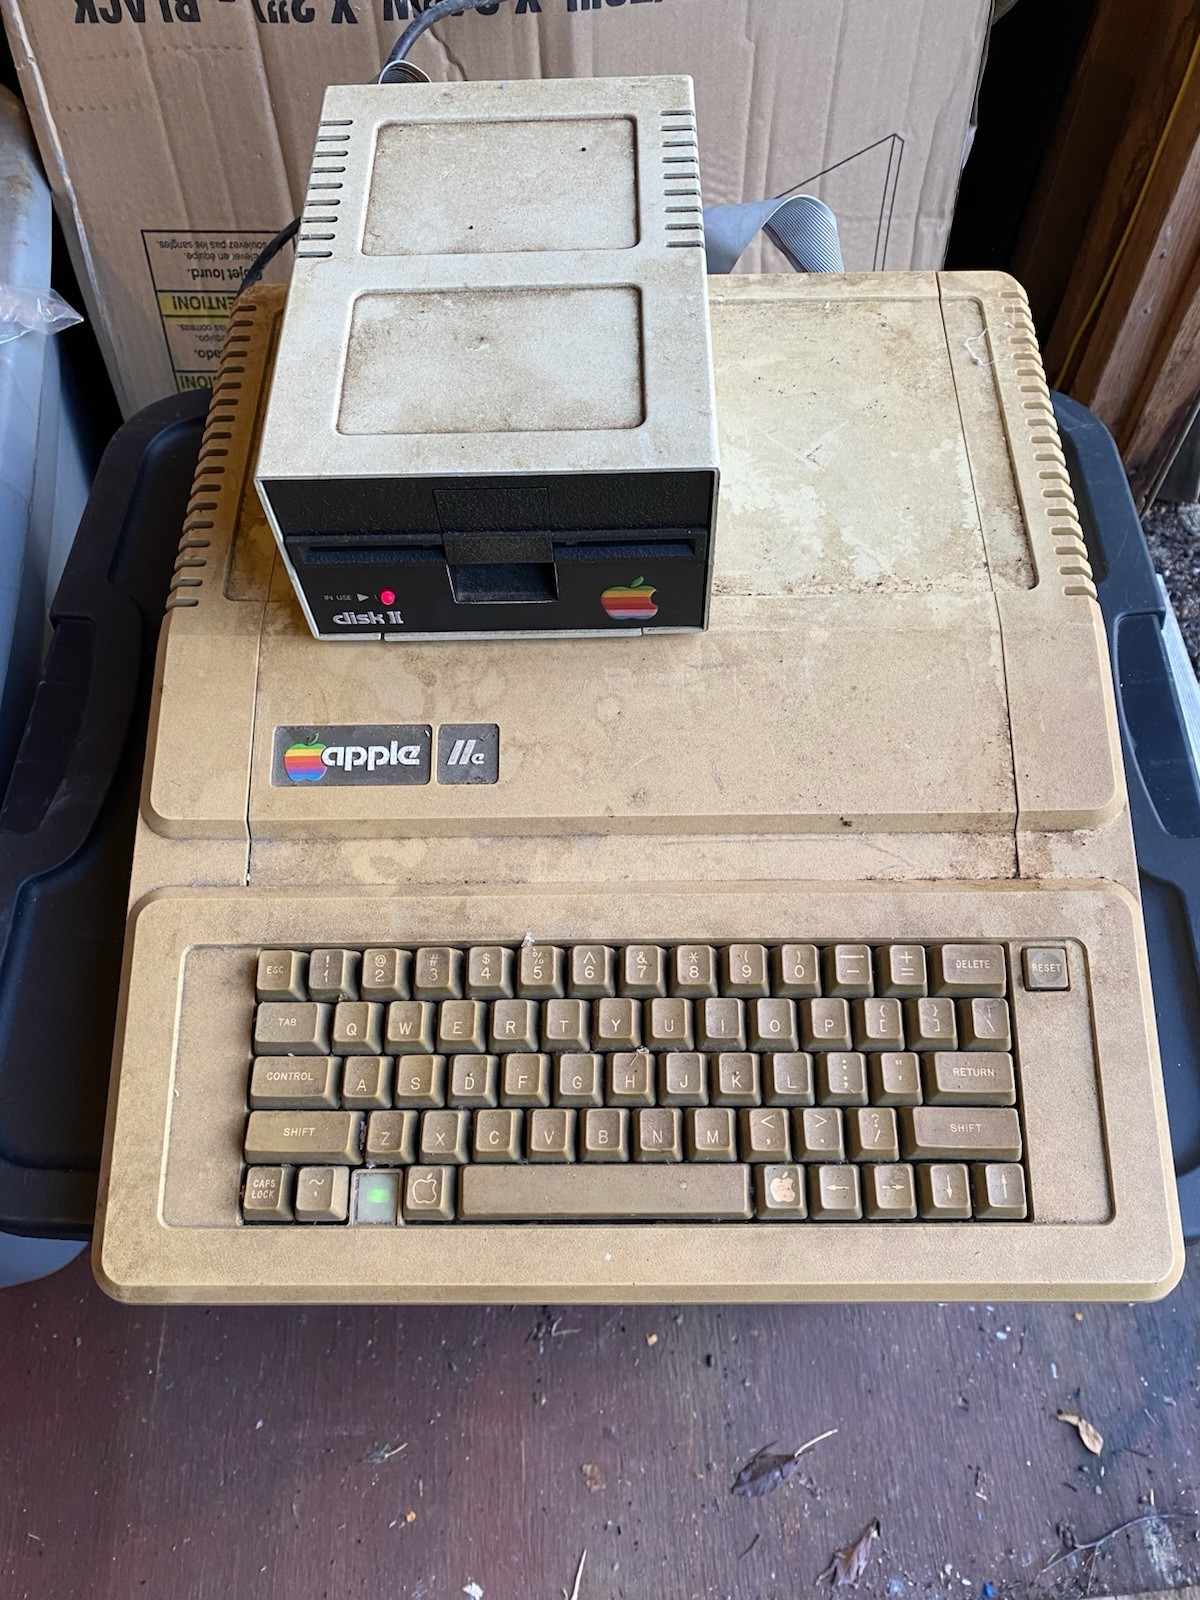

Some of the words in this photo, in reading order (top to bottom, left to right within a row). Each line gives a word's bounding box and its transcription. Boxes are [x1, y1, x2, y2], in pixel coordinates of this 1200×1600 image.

[187, 268, 225, 281] lourd.
[332, 611, 386, 625] disk
[320, 740, 420, 772] apple
[326, 955, 330, 967] !
[374, 955, 386, 967] @
[428, 954, 439, 966] #
[482, 952, 490, 964] $
[532, 950, 544, 964] %
[637, 951, 648, 964] &
[744, 950, 748, 962] (
[796, 950, 801, 962] )
[900, 952, 913, 964] +
[266, 966, 284, 974] ESC
[956, 960, 990, 969] DELETE
[1032, 963, 1061, 972] RESET
[324, 971, 328, 982] 1
[375, 970, 385, 982] 2
[428, 968, 438, 980] 3
[481, 968, 490, 980] 4
[534, 966, 542, 980] 5
[584, 966, 595, 978] 6
[638, 966, 647, 978] 7
[690, 966, 699, 978] 8
[742, 965, 752, 978] 9
[902, 968, 914, 976] =
[878, 1005, 885, 1018] {
[932, 1004, 939, 1017] }
[278, 1018, 297, 1026] TAB
[453, 1022, 462, 1034] E
[506, 1020, 516, 1034] R
[559, 1020, 568, 1033] T
[612, 1019, 621, 1032] Y
[664, 1020, 674, 1032] U
[721, 1020, 725, 1032] I
[770, 1020, 780, 1032] O
[824, 1020, 834, 1032] P
[880, 1020, 886, 1032] [
[934, 1019, 940, 1032] ]
[986, 1020, 995, 1032] \
[346, 1023, 357, 1036] Q
[400, 1022, 412, 1035] W
[842, 1060, 846, 1070] :
[266, 1072, 314, 1081] CONTROL
[953, 1068, 995, 1077] RETURN
[356, 1079, 367, 1092] A
[410, 1078, 420, 1090] S
[464, 1077, 474, 1090] D
[518, 1076, 528, 1088] F
[572, 1076, 582, 1089] G
[626, 1075, 636, 1088] H
[680, 1075, 688, 1088] J
[732, 1075, 742, 1088] K
[787, 1076, 797, 1088] L
[844, 1076, 848, 1088] ;
[760, 1115, 774, 1128] <
[814, 1114, 828, 1128] >
[871, 1114, 880, 1128] ?
[283, 1128, 316, 1136] SHIFT
[950, 1124, 982, 1132] SHIFT
[380, 1132, 390, 1146] Z
[435, 1132, 446, 1146] X
[489, 1131, 500, 1144] C
[544, 1130, 554, 1144] V
[598, 1130, 608, 1144] B
[652, 1130, 662, 1144] N
[707, 1130, 719, 1144] M
[874, 1130, 881, 1142] /
[254, 1178, 276, 1188] CAPS
[309, 1178, 324, 1186] ~
[252, 1190, 274, 1198] LOCK
